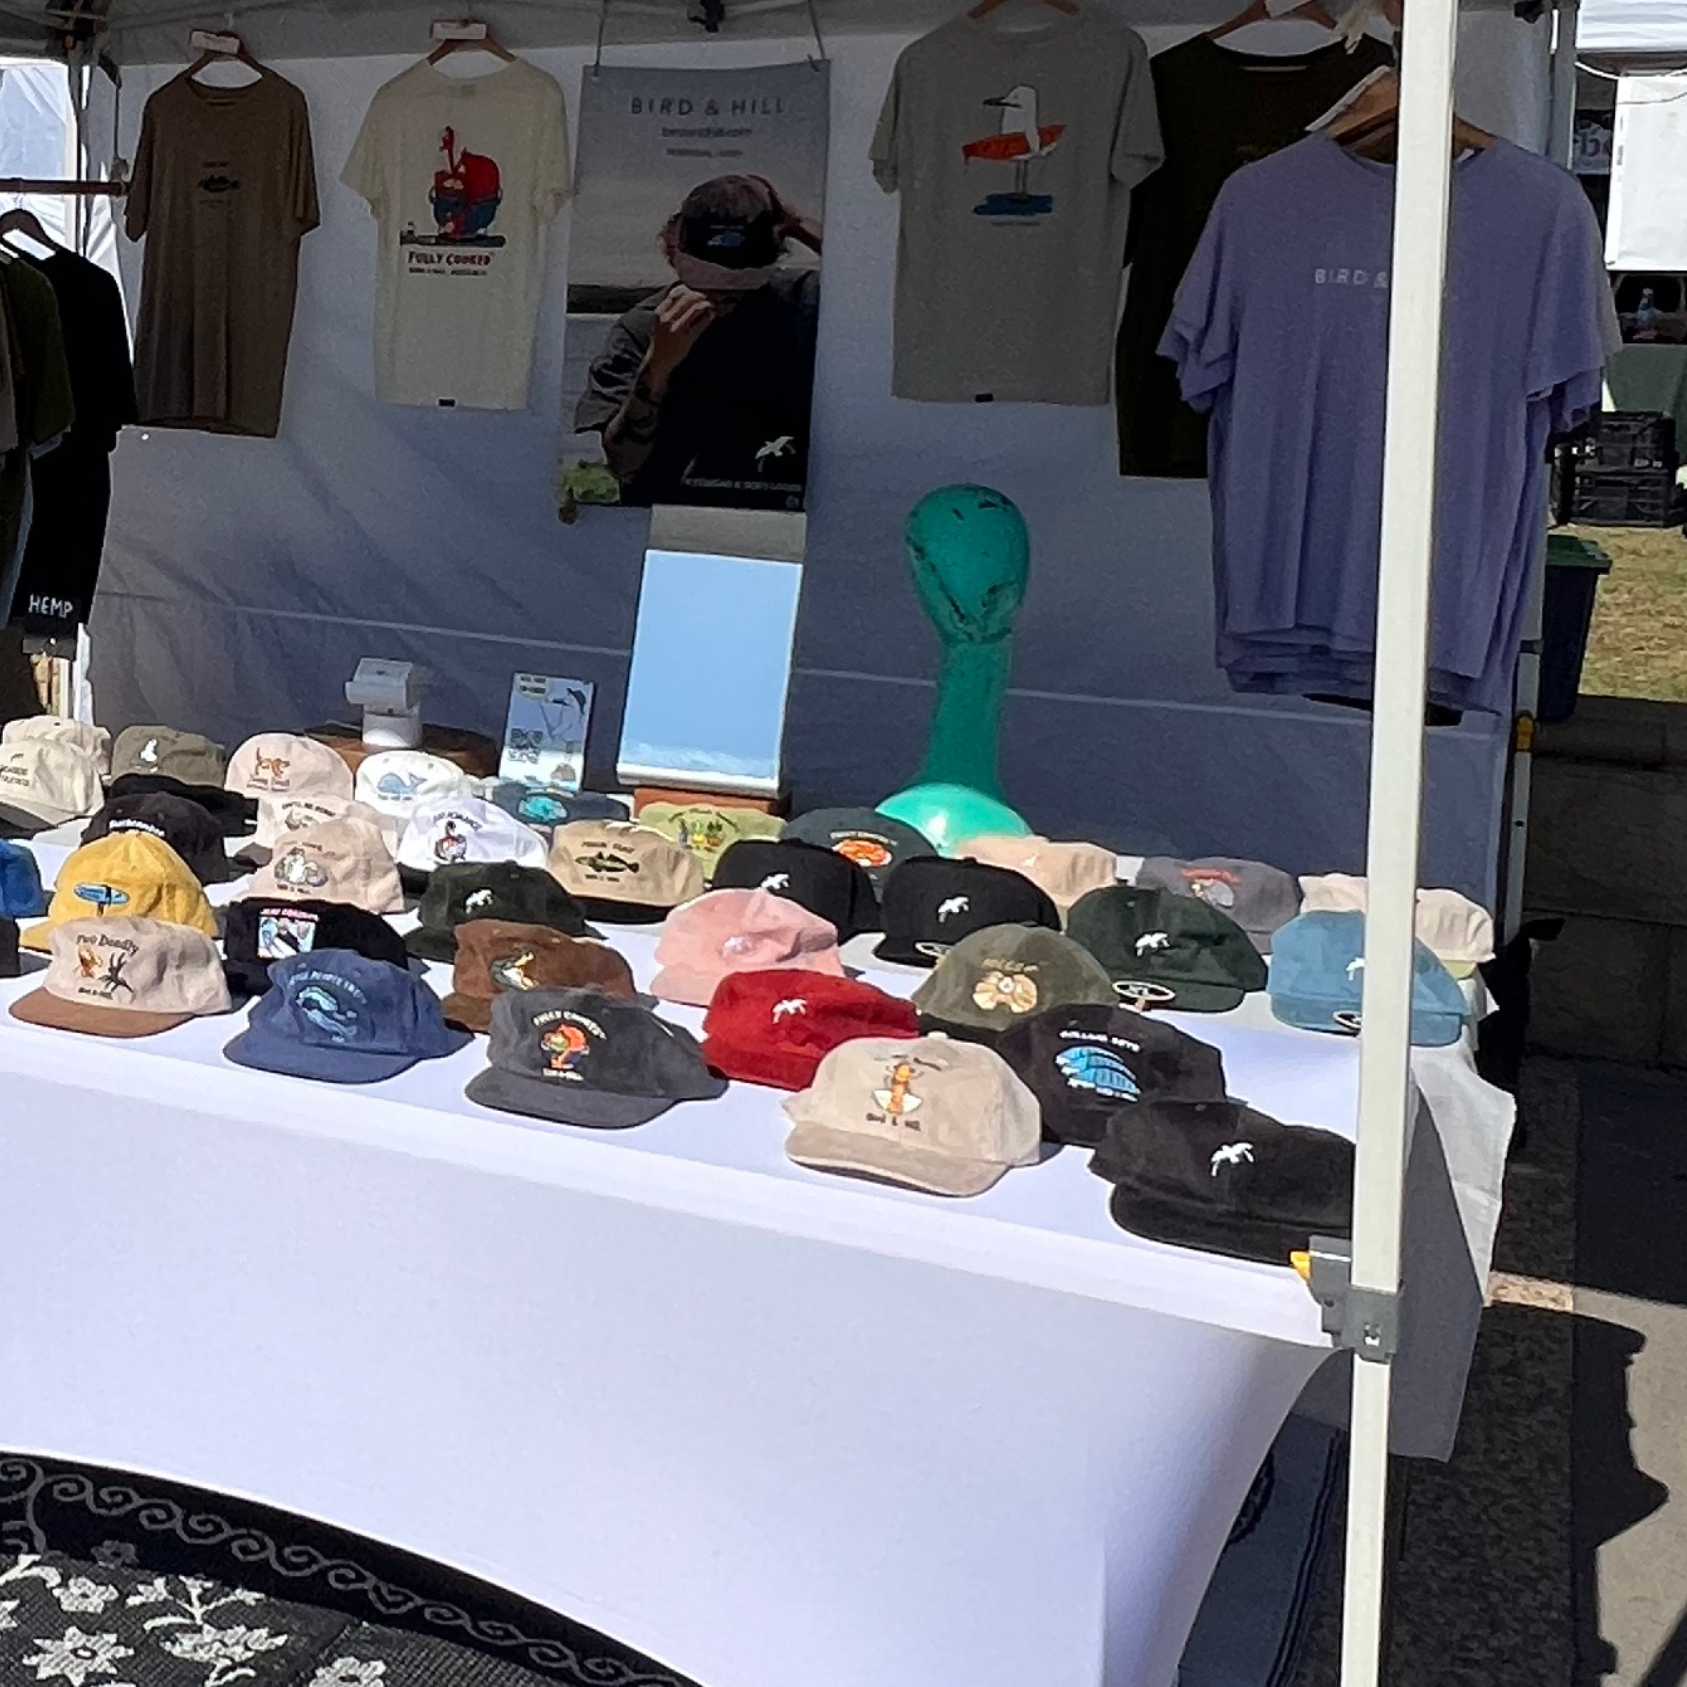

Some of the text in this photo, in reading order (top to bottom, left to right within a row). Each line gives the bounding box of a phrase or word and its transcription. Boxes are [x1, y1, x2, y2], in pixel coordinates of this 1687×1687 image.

[631, 96, 785, 116] BIRD & HILL
[408, 252, 443, 265] FULLY
[28, 593, 73, 619] HEMP
